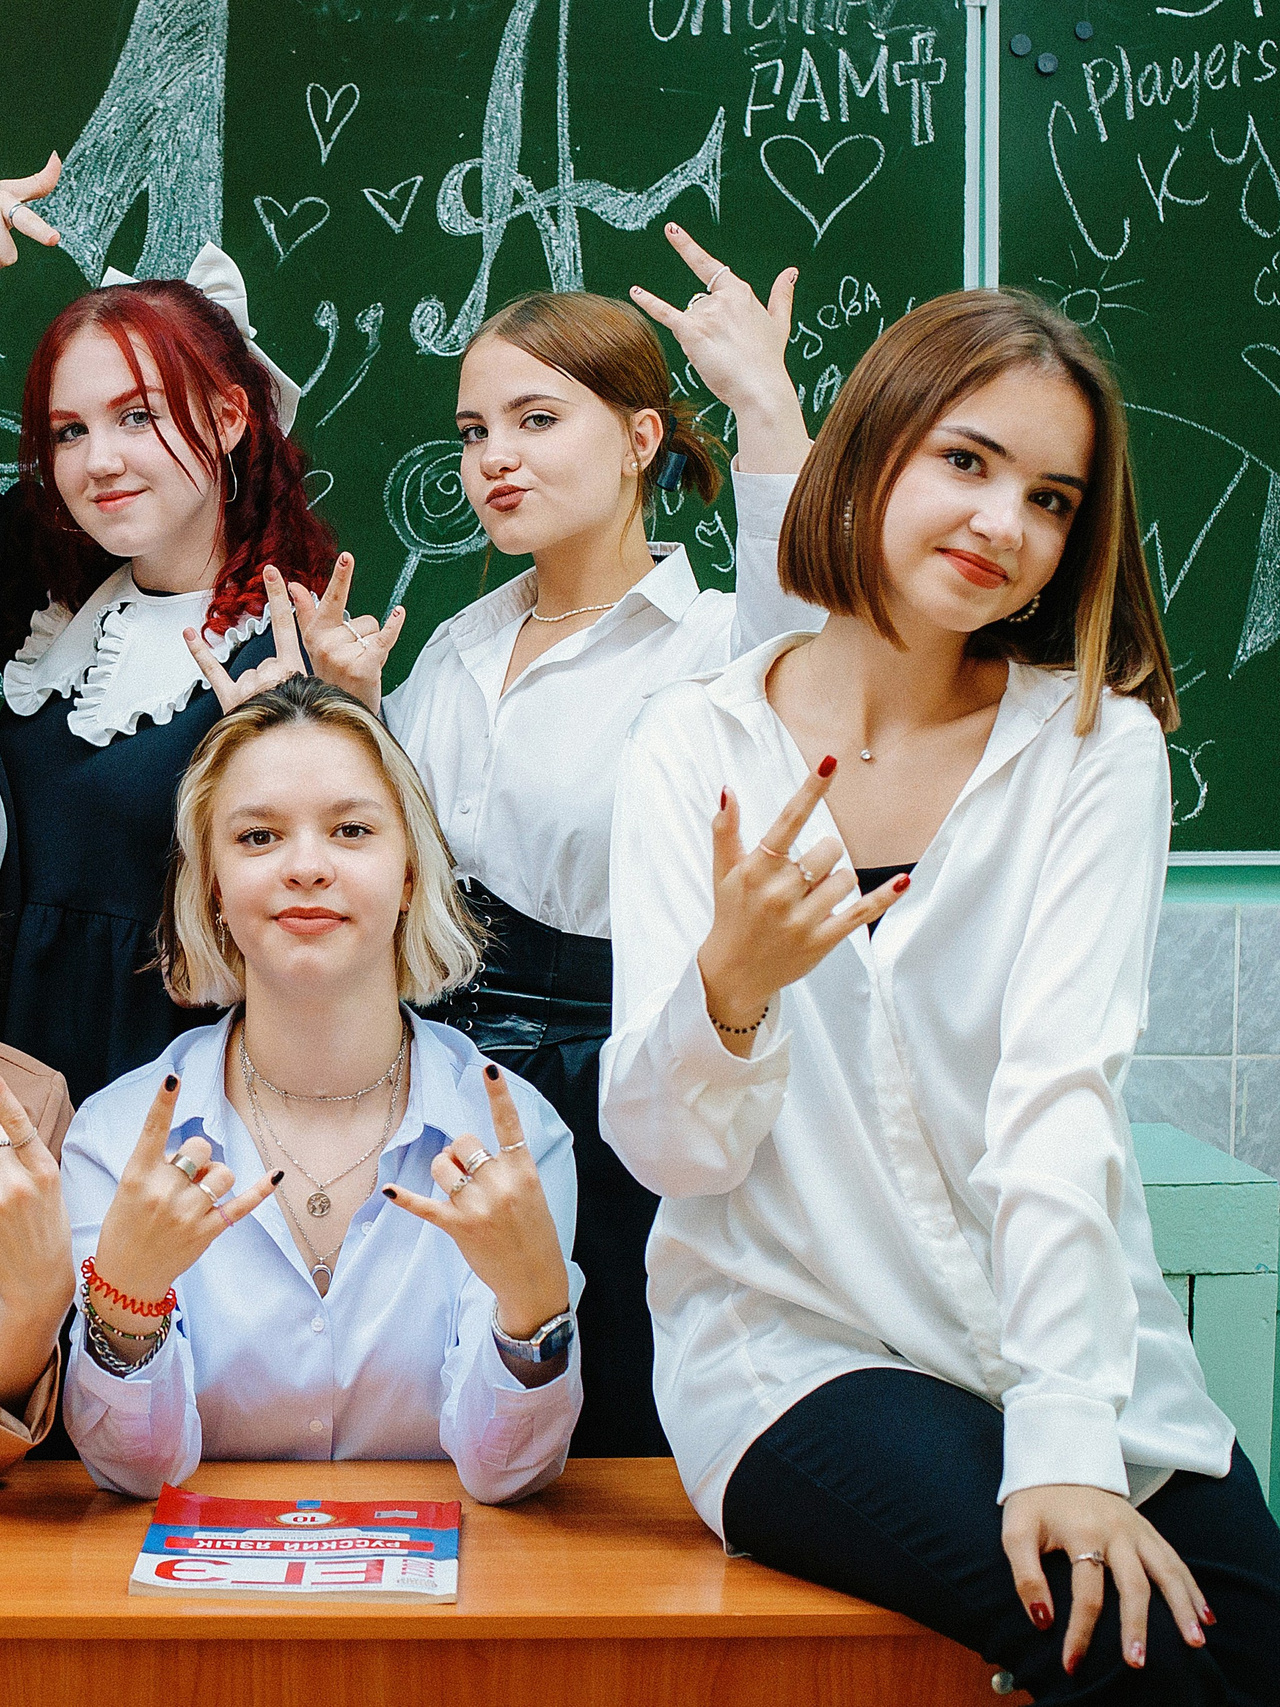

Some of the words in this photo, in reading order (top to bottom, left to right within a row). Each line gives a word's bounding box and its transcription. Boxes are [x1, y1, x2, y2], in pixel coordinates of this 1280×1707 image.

[1082, 38, 1280, 143] Players
[292, 1515, 318, 1523] 10
[195, 1539, 272, 1551] ЯЗЫК
[283, 1539, 401, 1552] РУССКИЙ
[154, 1558, 385, 1586] ЕГЭ
